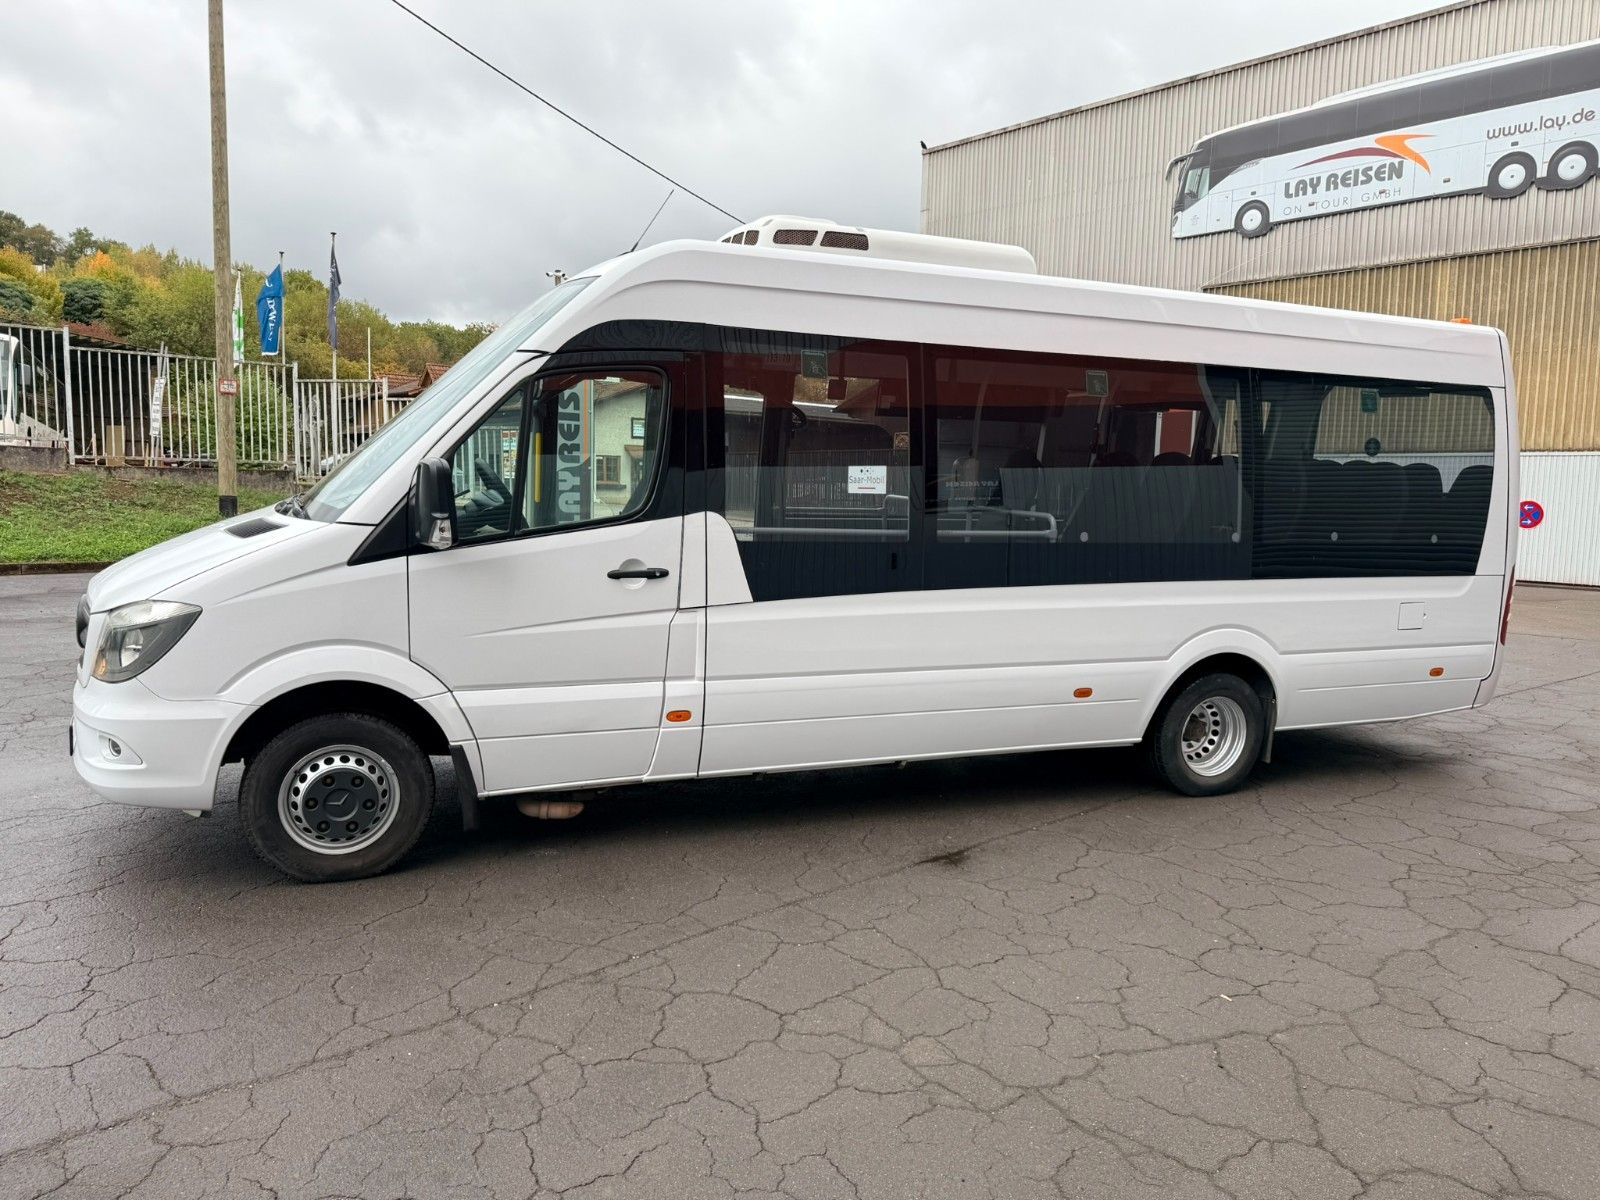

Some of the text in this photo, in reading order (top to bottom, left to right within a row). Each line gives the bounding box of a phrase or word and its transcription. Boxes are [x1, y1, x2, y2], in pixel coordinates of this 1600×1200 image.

[1486, 107, 1596, 140] www.lay.de
[1284, 160, 1405, 199] LAY REISEN
[1282, 204, 1302, 216] ON
[1314, 196, 1349, 211] TOUR
[557, 385, 581, 464] REIS
[848, 475, 885, 484] Saar-Mobil
